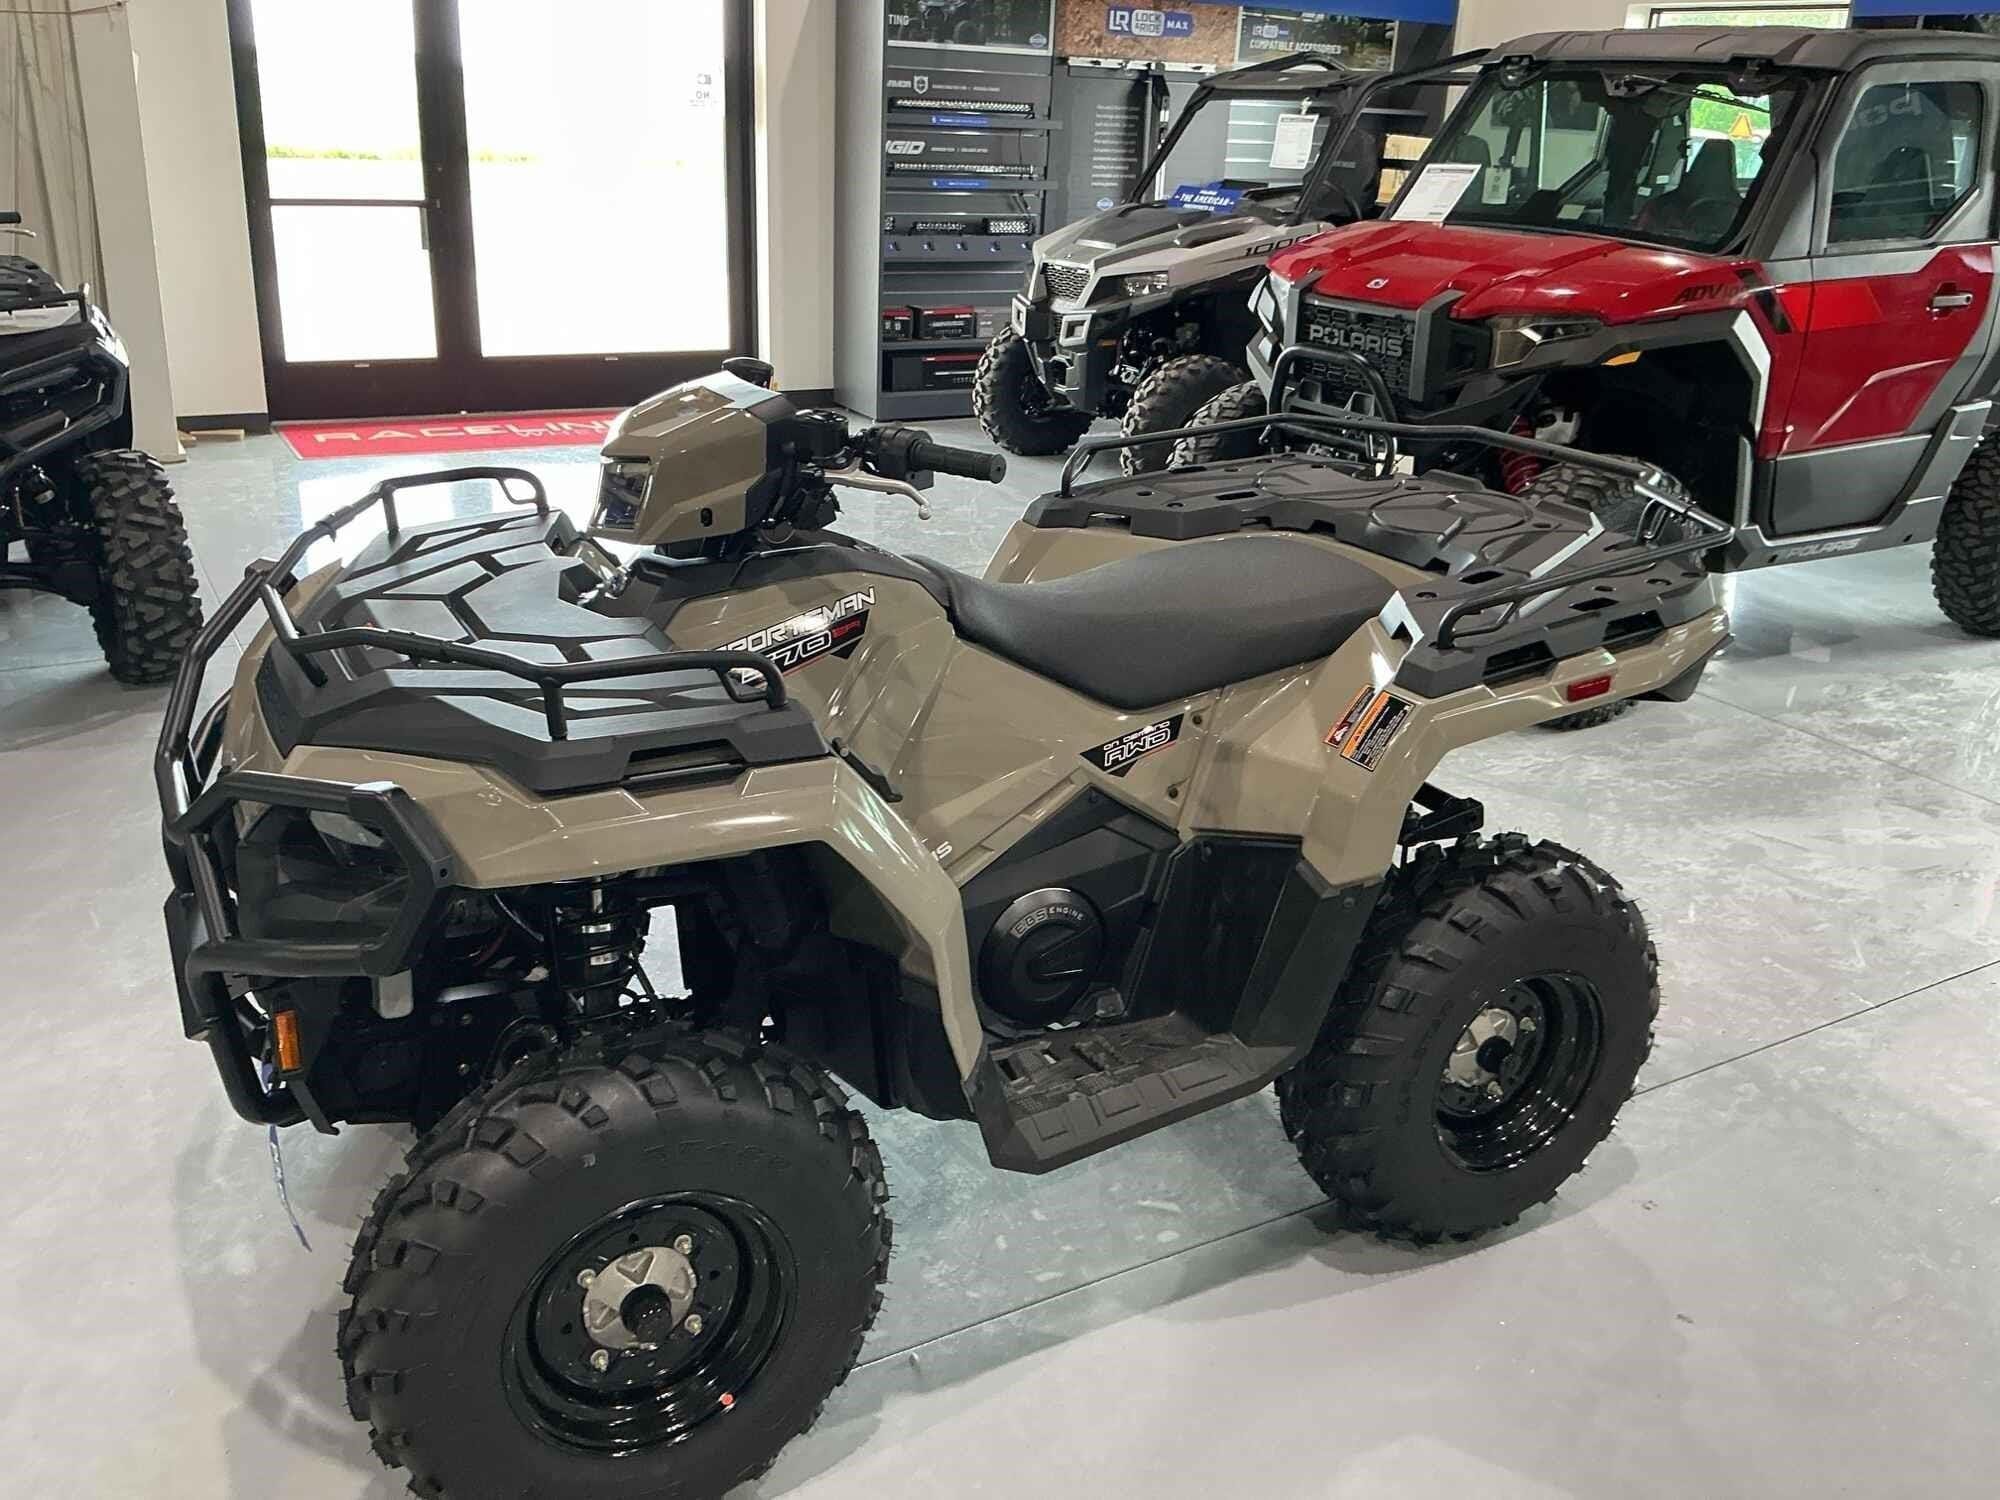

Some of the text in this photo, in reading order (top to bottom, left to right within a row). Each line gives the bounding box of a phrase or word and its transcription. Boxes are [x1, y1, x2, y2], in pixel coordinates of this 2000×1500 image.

[1166, 20, 1189, 30] MAX
[1250, 39, 1342, 55] COMPATIBLE ACCESSORIES
[1179, 193, 1195, 202] THE
[1193, 195, 1230, 206] AMERICAN
[1672, 283, 1724, 304] ADV
[1309, 324, 1405, 358] POLARIS
[313, 418, 614, 444] RACELIN
[1785, 537, 1862, 560] POLARIS
[714, 586, 876, 652] PORTSMAN
[1104, 728, 1171, 767] AWD
[1049, 906, 1084, 921] ENGINE
